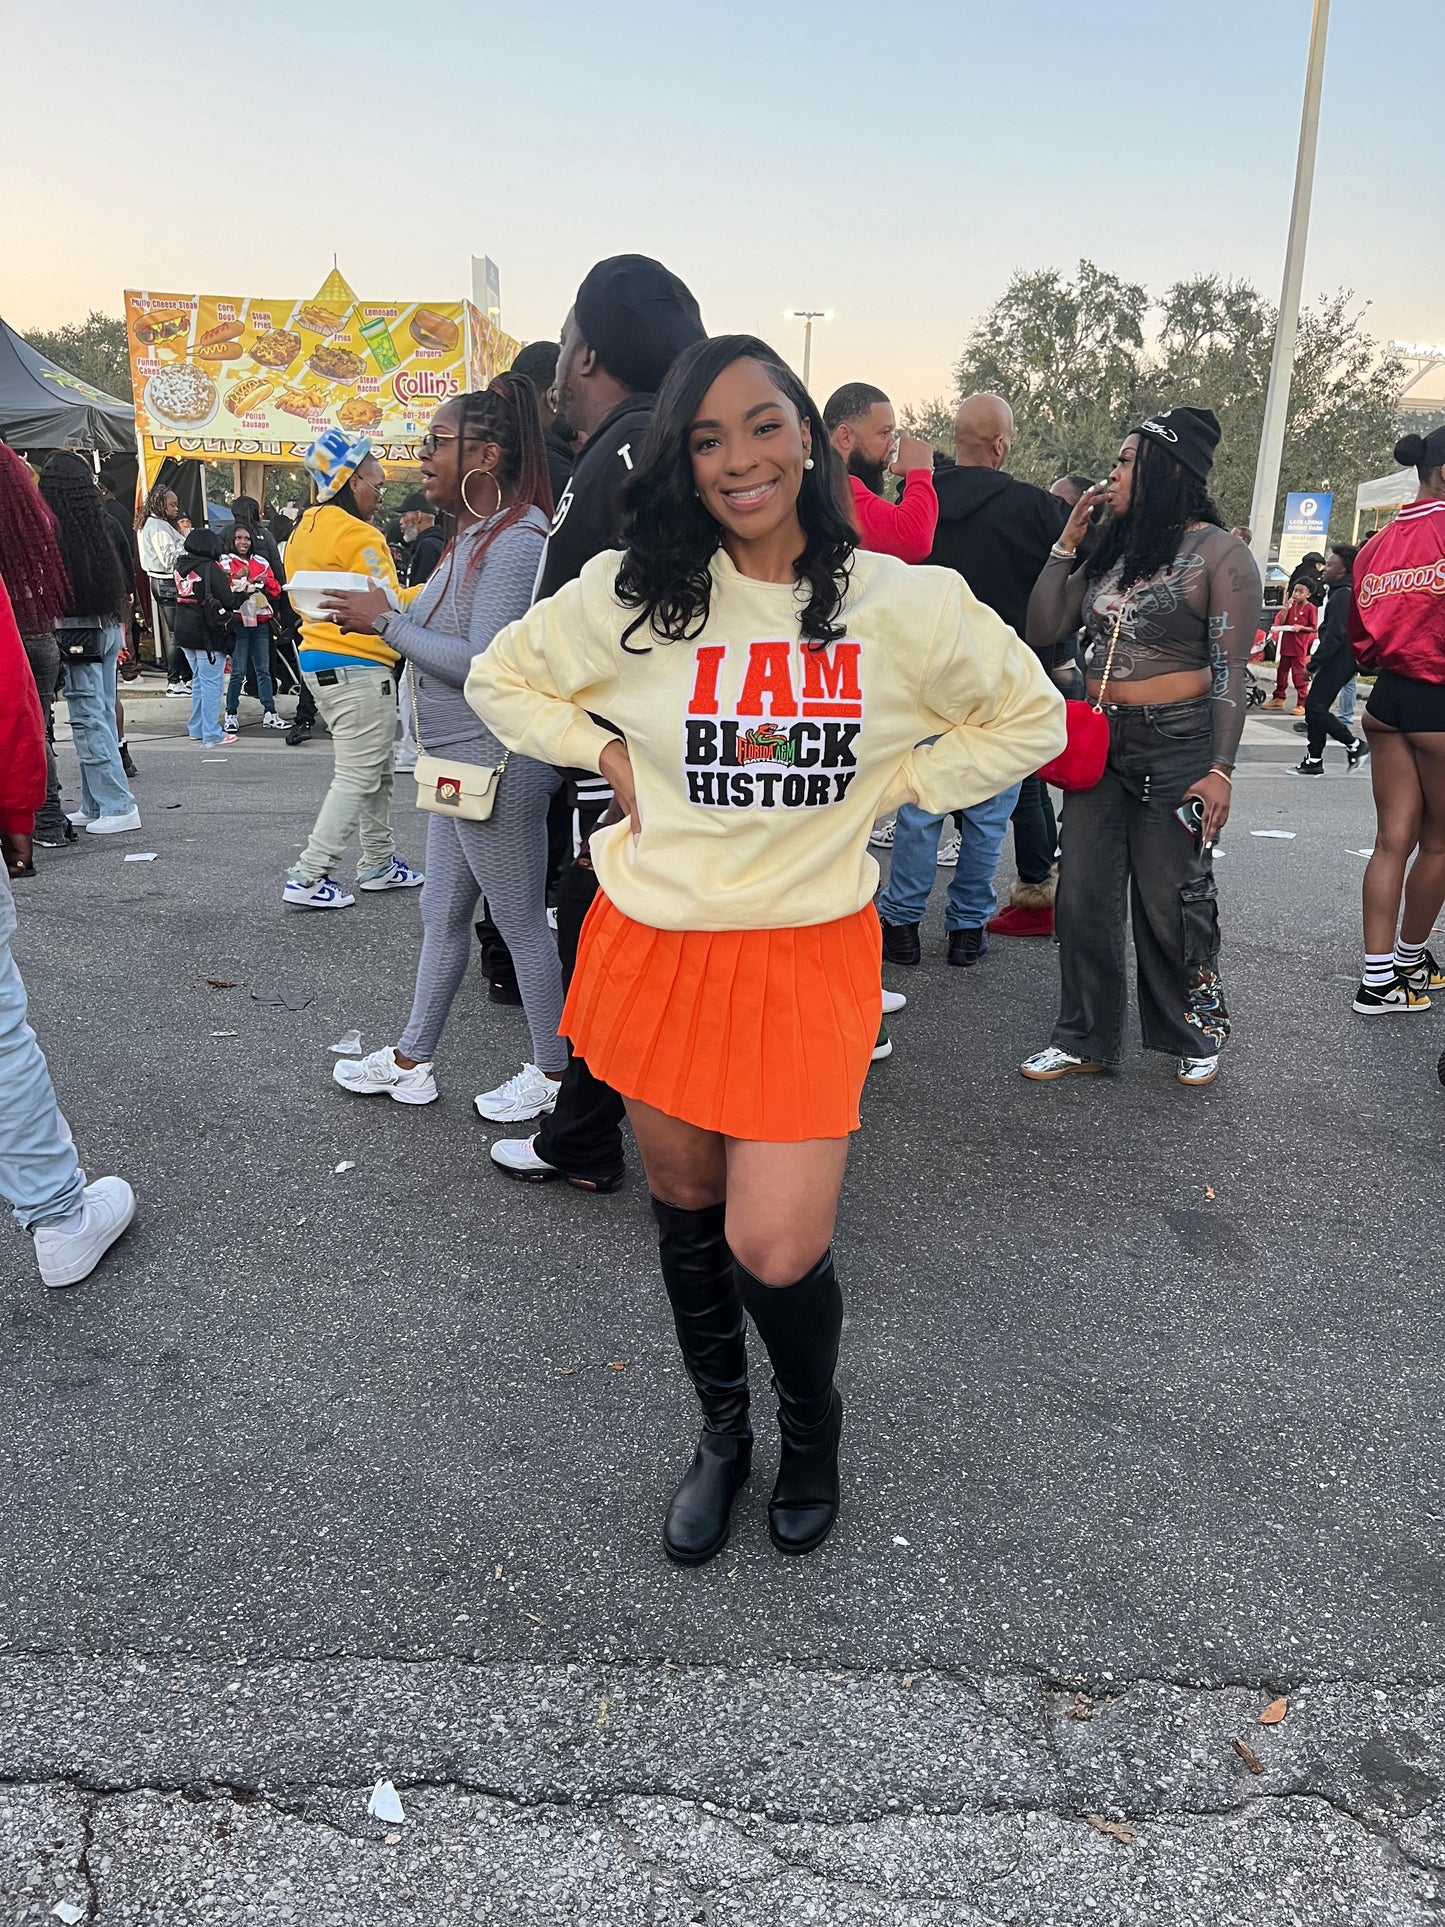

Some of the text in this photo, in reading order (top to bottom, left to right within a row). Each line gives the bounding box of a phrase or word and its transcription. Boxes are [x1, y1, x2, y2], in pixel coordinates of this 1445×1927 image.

[152, 300, 177, 309] Cheese
[178, 301, 198, 310] Steak
[217, 303, 235, 312] Corn
[218, 312, 235, 321] Dogs
[251, 312, 271, 321] Steak
[364, 308, 398, 317] Lemonade
[253, 320, 272, 330] Fries
[334, 333, 352, 342] Fries
[415, 350, 442, 358] Burgers
[137, 358, 161, 366] Funnel
[139, 366, 161, 375] Cakes
[359, 376, 378, 384] Steak
[357, 385, 380, 393] Nachos
[394, 370, 459, 402] Collin's
[245, 412, 266, 420] Polish
[307, 416, 331, 425] Cheese
[242, 420, 270, 429] Sausage
[688, 641, 862, 717] I AM
[685, 720, 861, 768] BLCK
[686, 771, 856, 808] HISTORY
